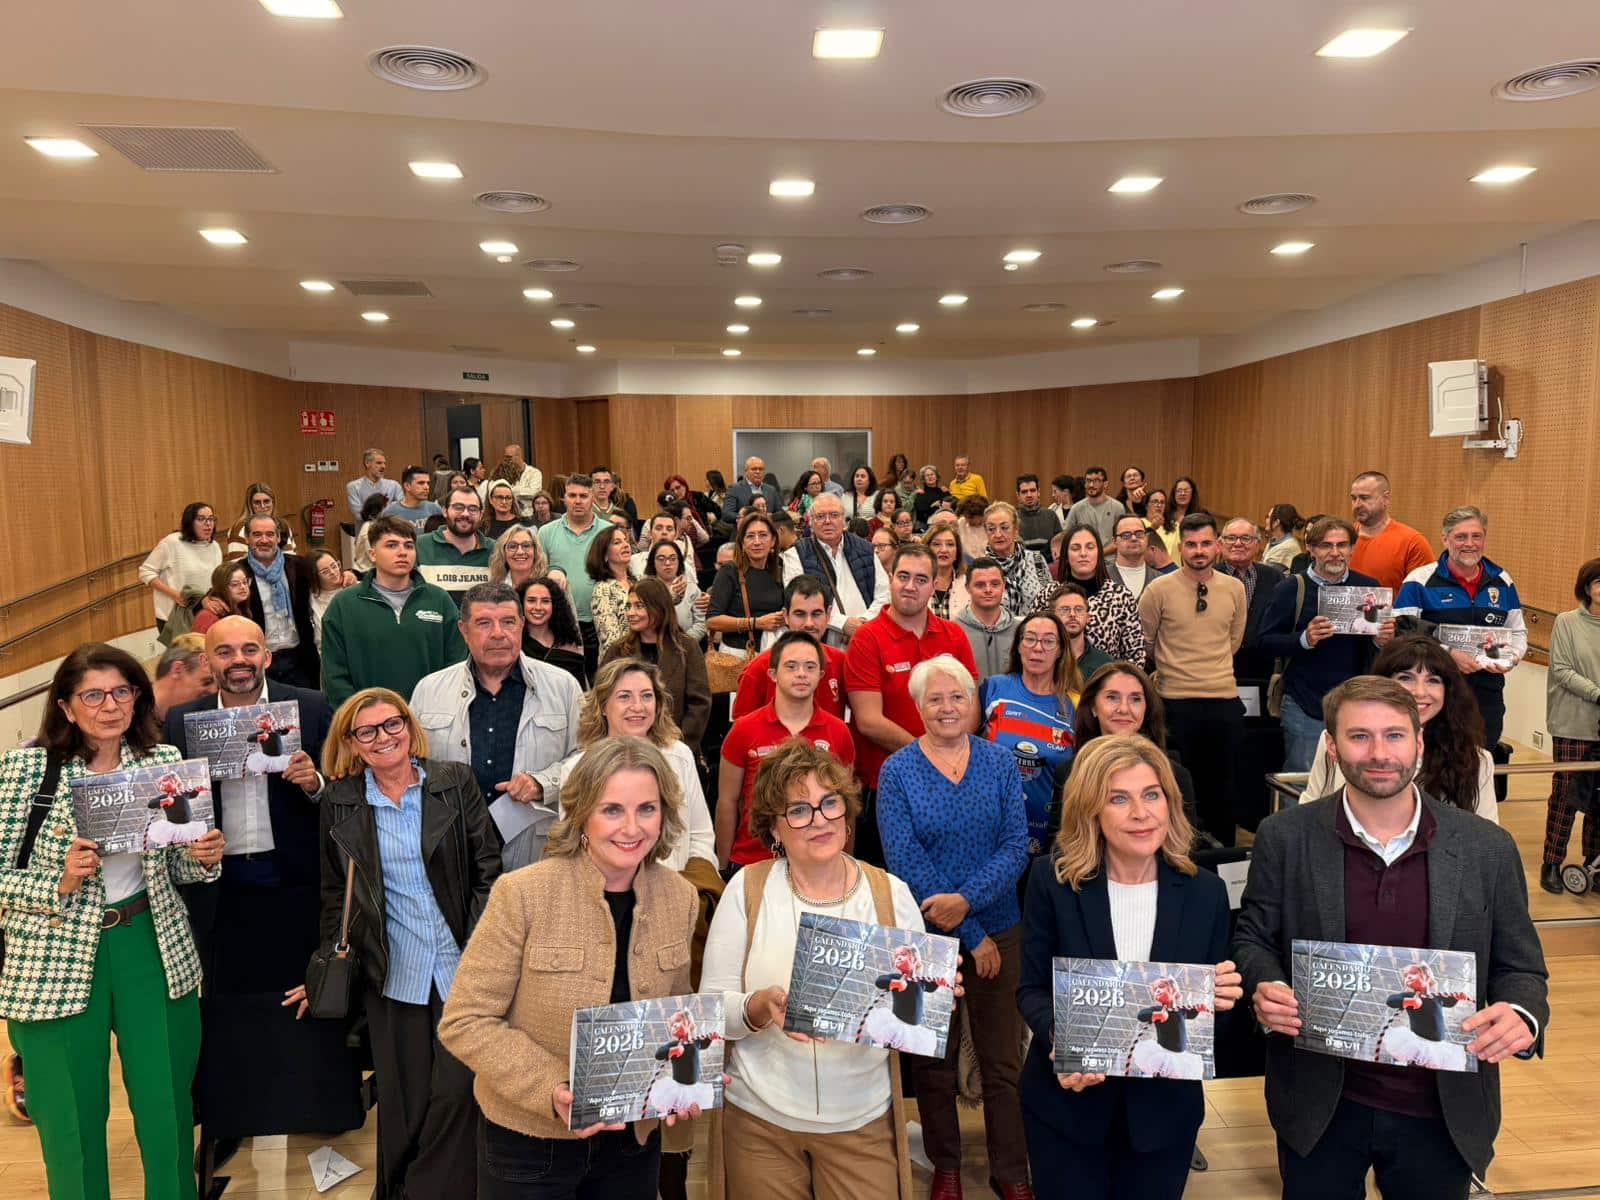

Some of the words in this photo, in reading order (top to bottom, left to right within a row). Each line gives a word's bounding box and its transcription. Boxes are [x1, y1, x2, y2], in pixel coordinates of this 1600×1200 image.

[436, 574, 458, 582] LOIS
[460, 574, 489, 582] JEANS
[1327, 595, 1351, 605] 2026
[199, 726, 237, 741] 2026
[90, 791, 136, 809] 2026
[814, 936, 867, 950] CALENDARIO
[812, 945, 865, 971] 2026
[1312, 961, 1371, 973] CALENDARIO
[1072, 977, 1124, 988] CALENDARIO
[1312, 971, 1372, 993] 2026
[1072, 987, 1125, 1008] 2026
[594, 1031, 645, 1055] 2026
